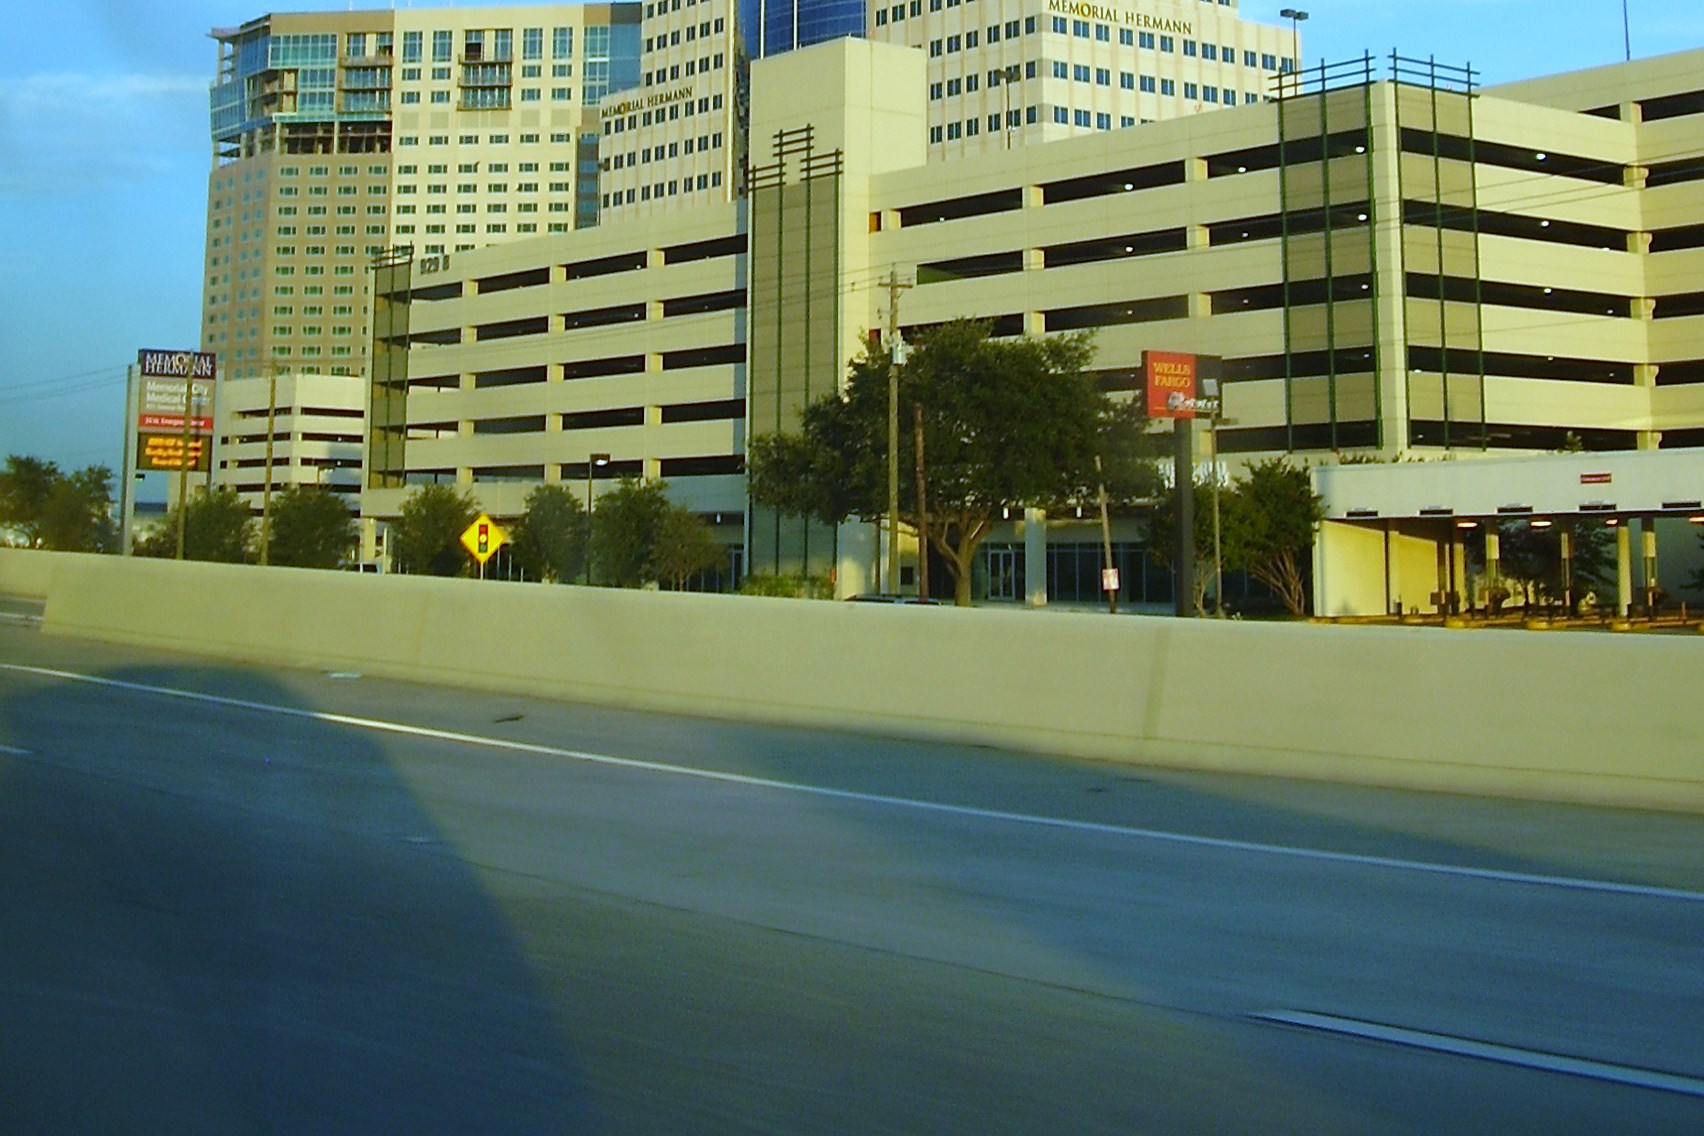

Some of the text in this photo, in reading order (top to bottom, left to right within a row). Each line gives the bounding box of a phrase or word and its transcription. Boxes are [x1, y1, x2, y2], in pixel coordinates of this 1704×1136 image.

[1125, 11, 1192, 34] HERMANN
[601, 86, 693, 117] MEMORIAL HERMANN
[145, 352, 211, 367] MEMOIAL
[1153, 362, 1190, 374] WELLS
[1155, 375, 1190, 388] FARGO
